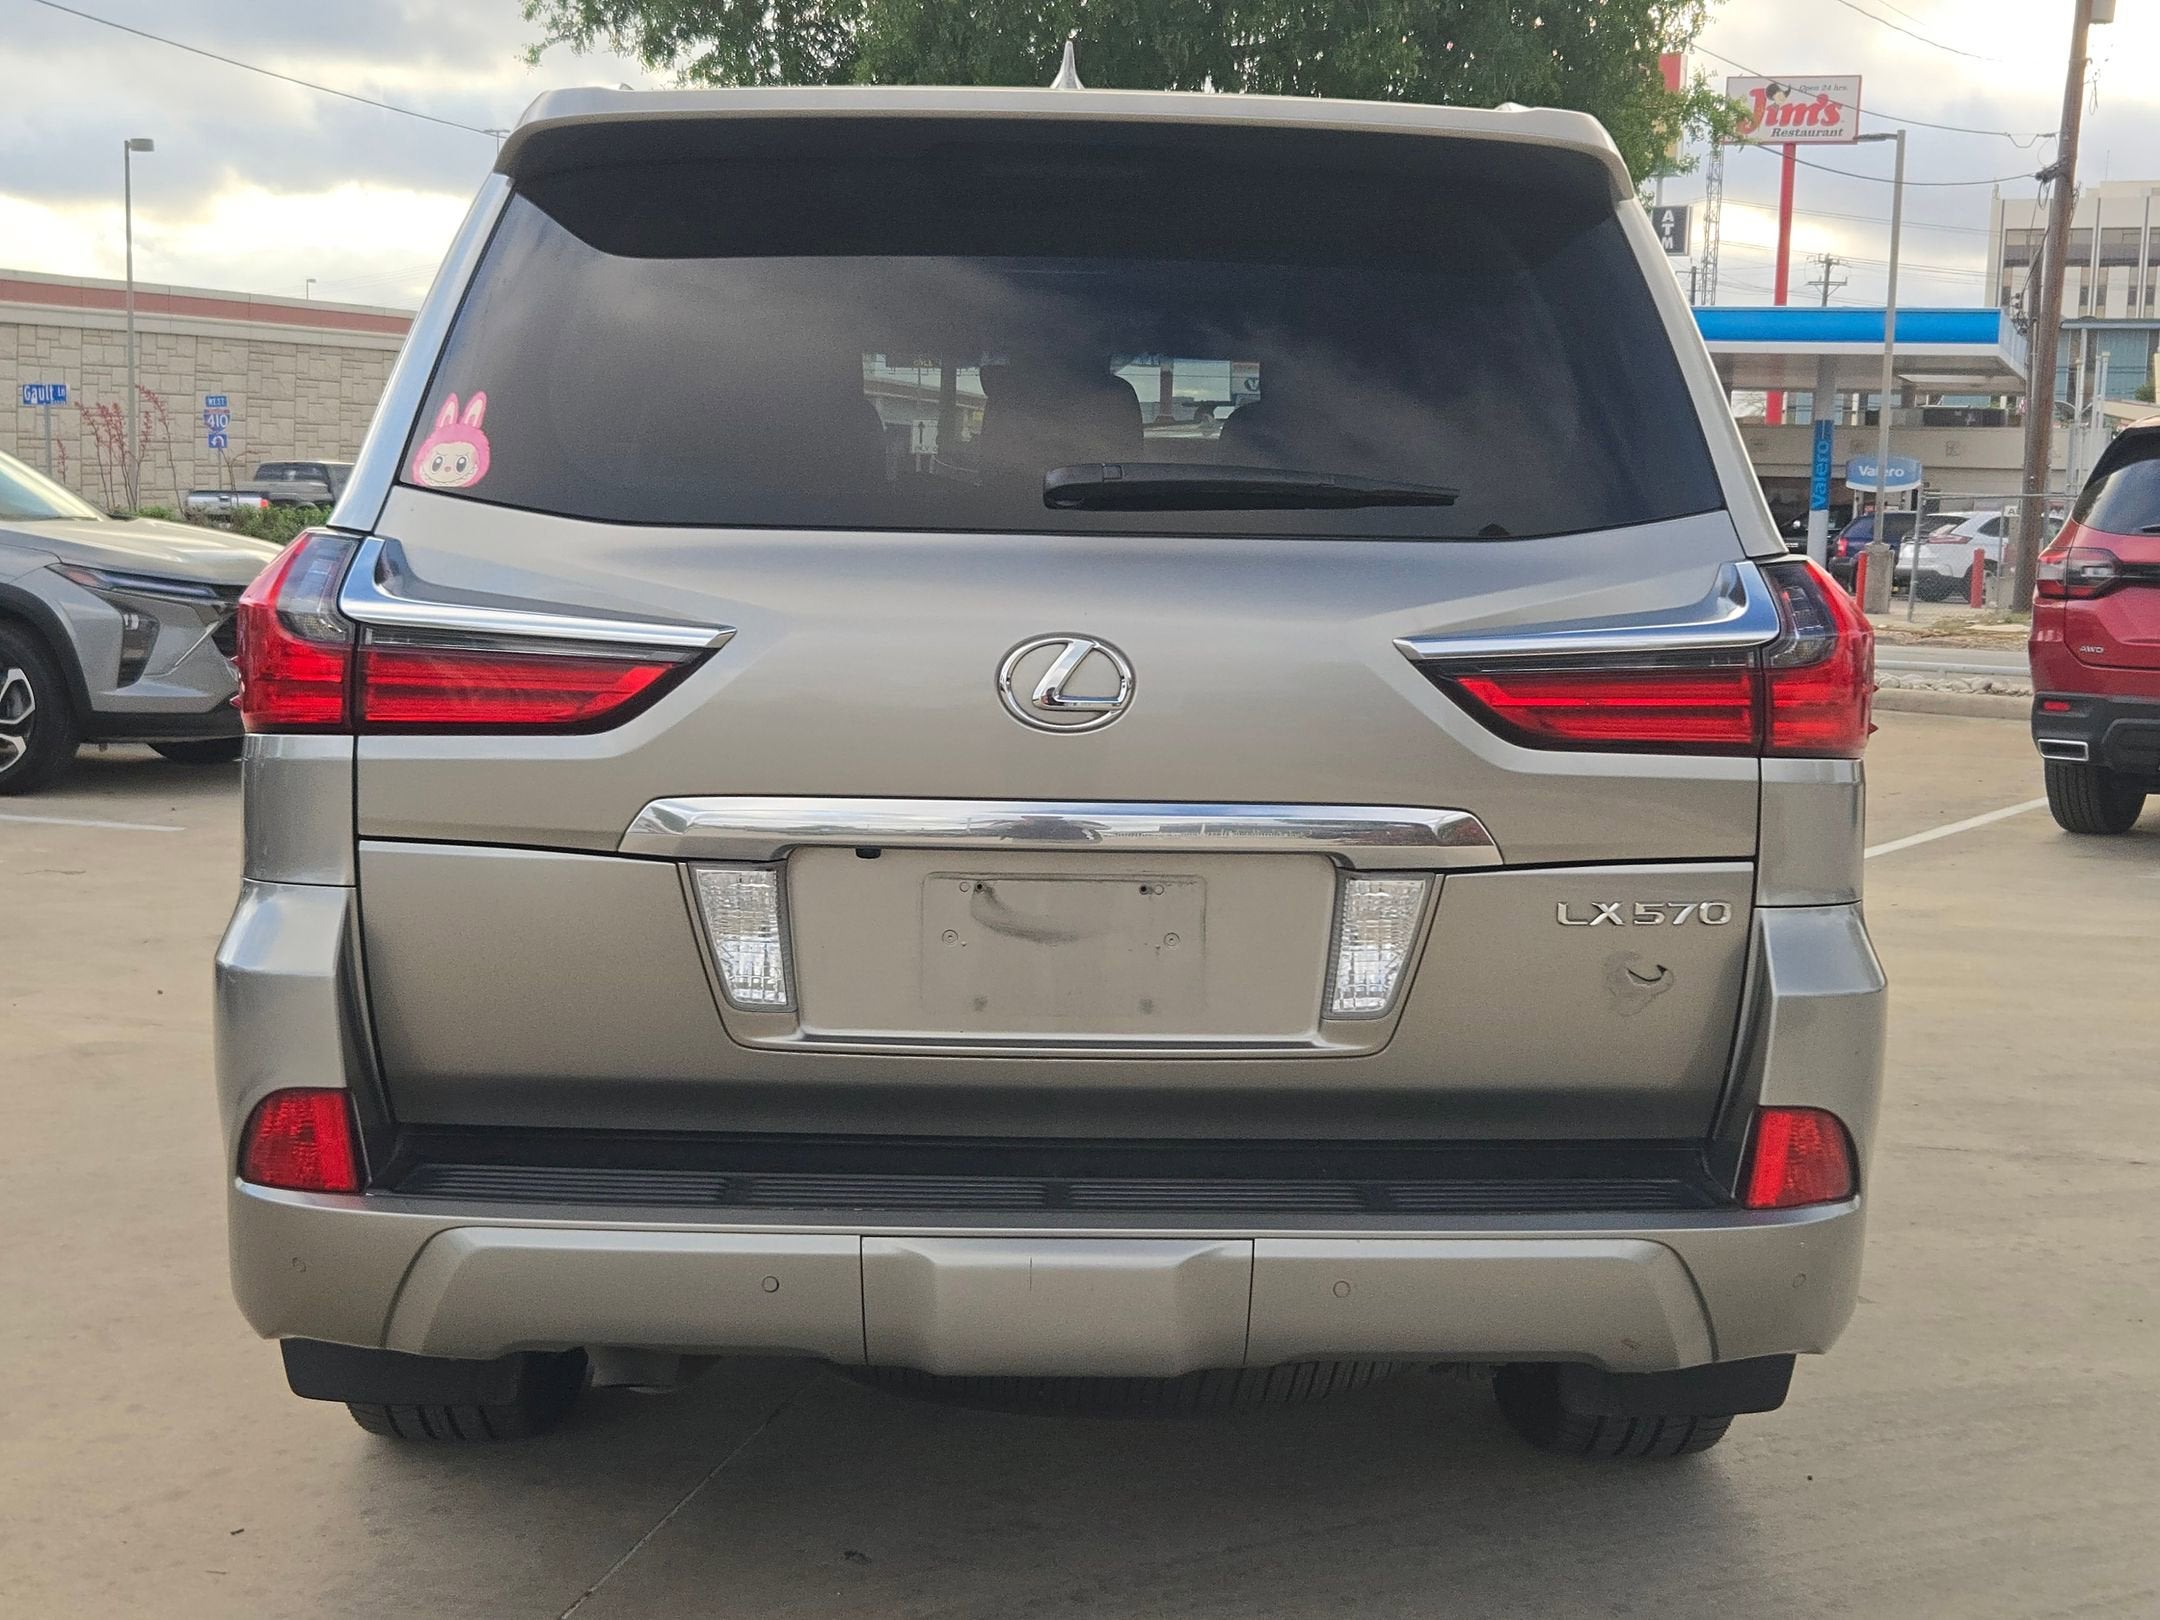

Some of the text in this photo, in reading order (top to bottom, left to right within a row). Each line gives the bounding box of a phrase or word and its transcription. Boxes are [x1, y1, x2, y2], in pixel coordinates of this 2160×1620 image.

[1800, 84, 1820, 93] Open
[1736, 87, 1842, 134] Jim's
[1771, 128, 1844, 138] Restaurant
[1661, 209, 1675, 249] ATM
[24, 384, 54, 401] Gault
[208, 414, 228, 428] 410
[1811, 439, 1830, 508] Valero
[2080, 645, 2104, 653] AWD
[1556, 901, 1733, 926] LX 570
